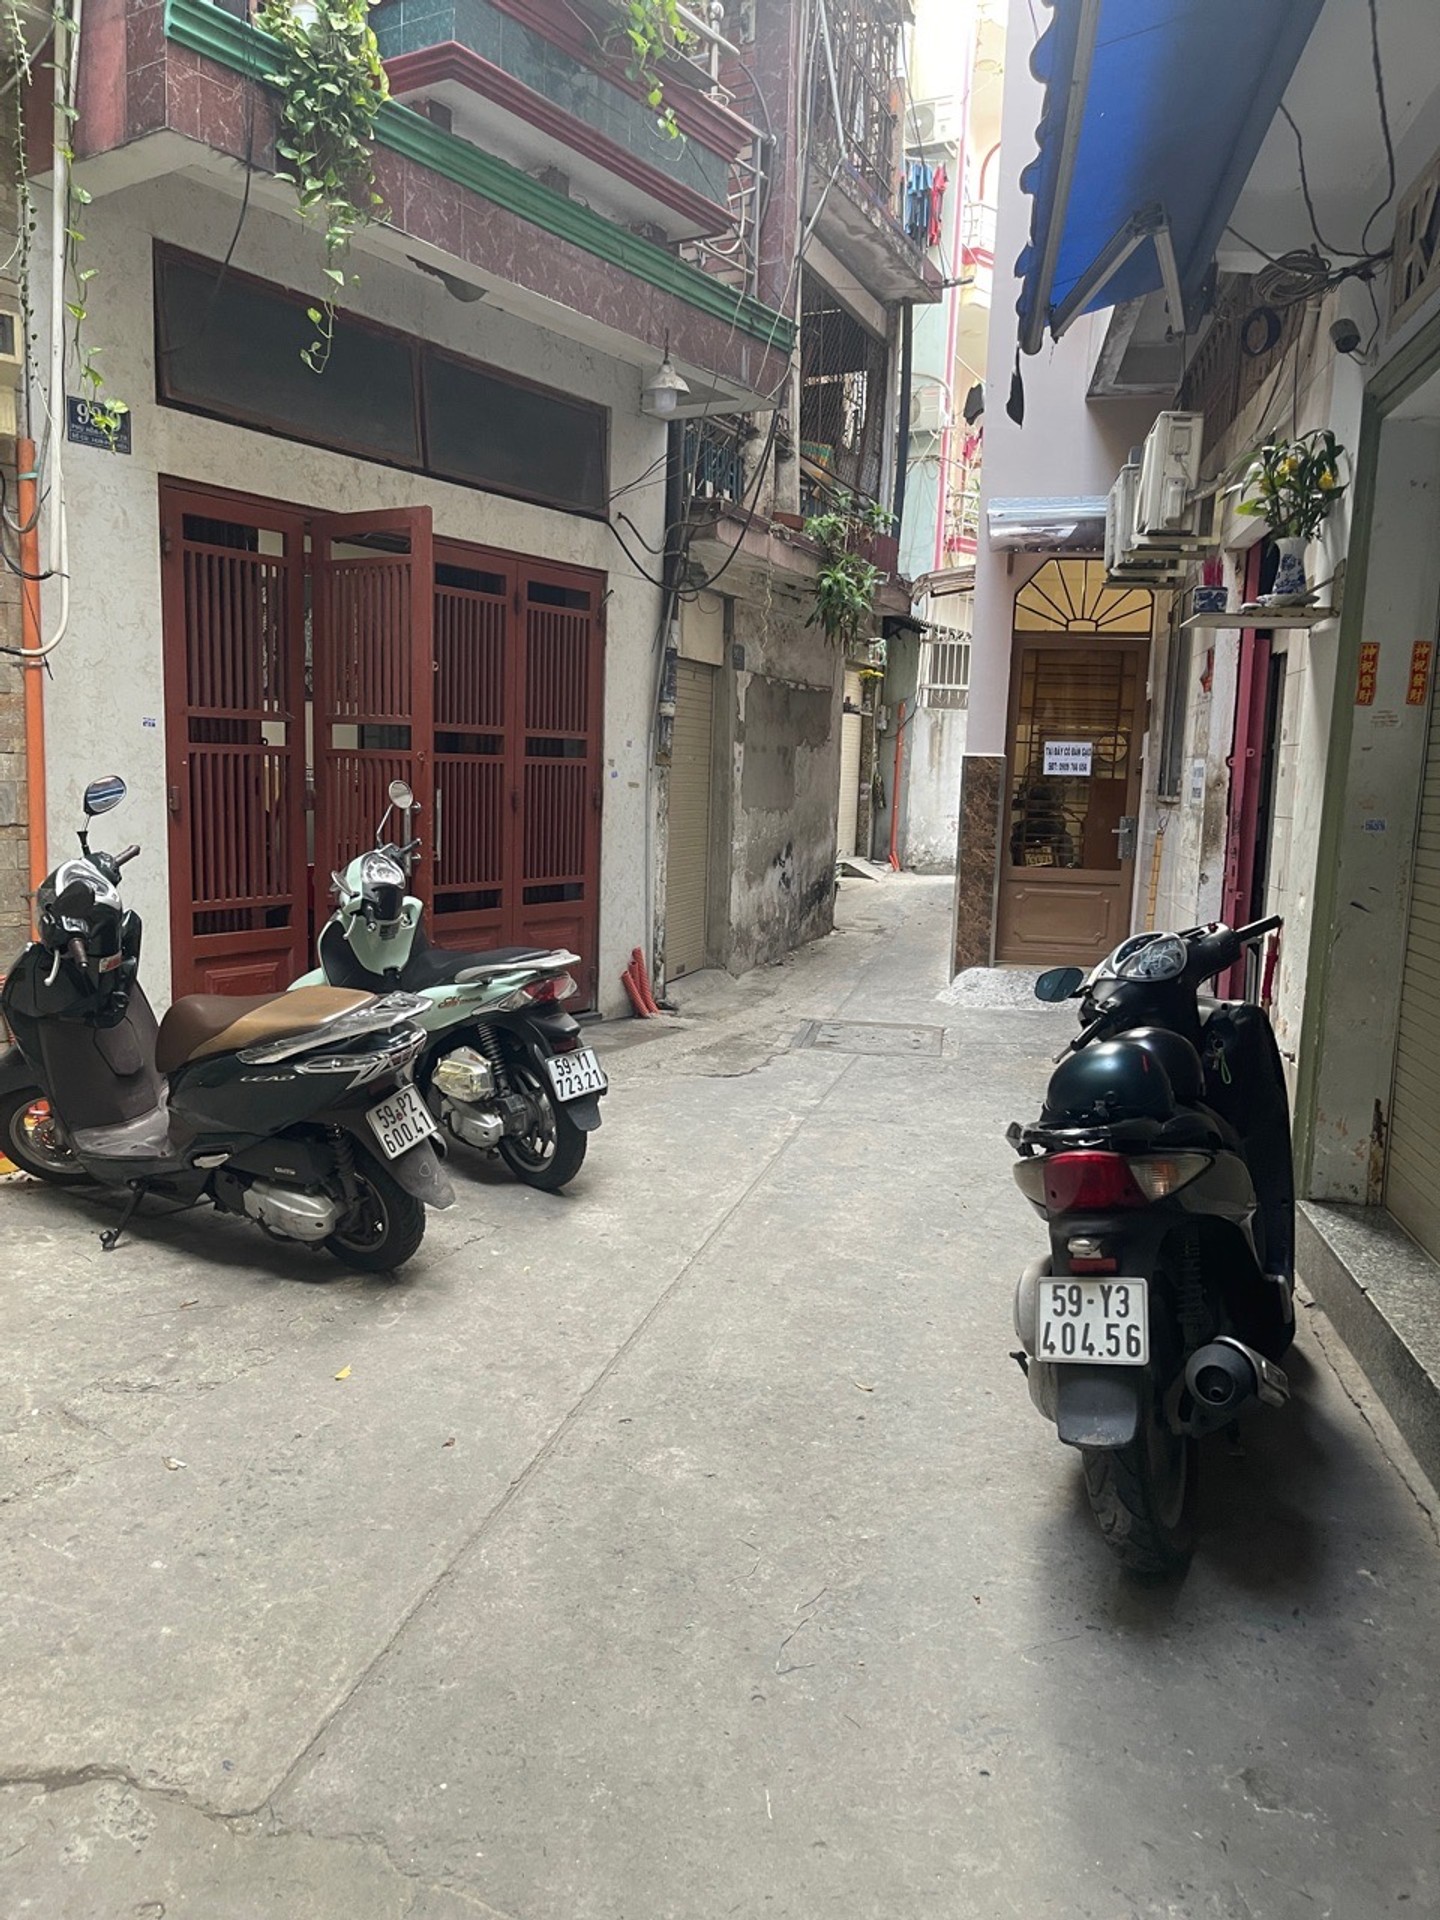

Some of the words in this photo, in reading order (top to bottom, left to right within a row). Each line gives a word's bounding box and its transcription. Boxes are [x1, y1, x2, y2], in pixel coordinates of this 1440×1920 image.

[555, 1053, 590, 1076] 59-Y1
[556, 1070, 601, 1098] 723.21
[383, 1111, 431, 1153] 600.41
[1052, 1284, 1130, 1318] 59-Y3
[1042, 1321, 1142, 1357] 404.56
